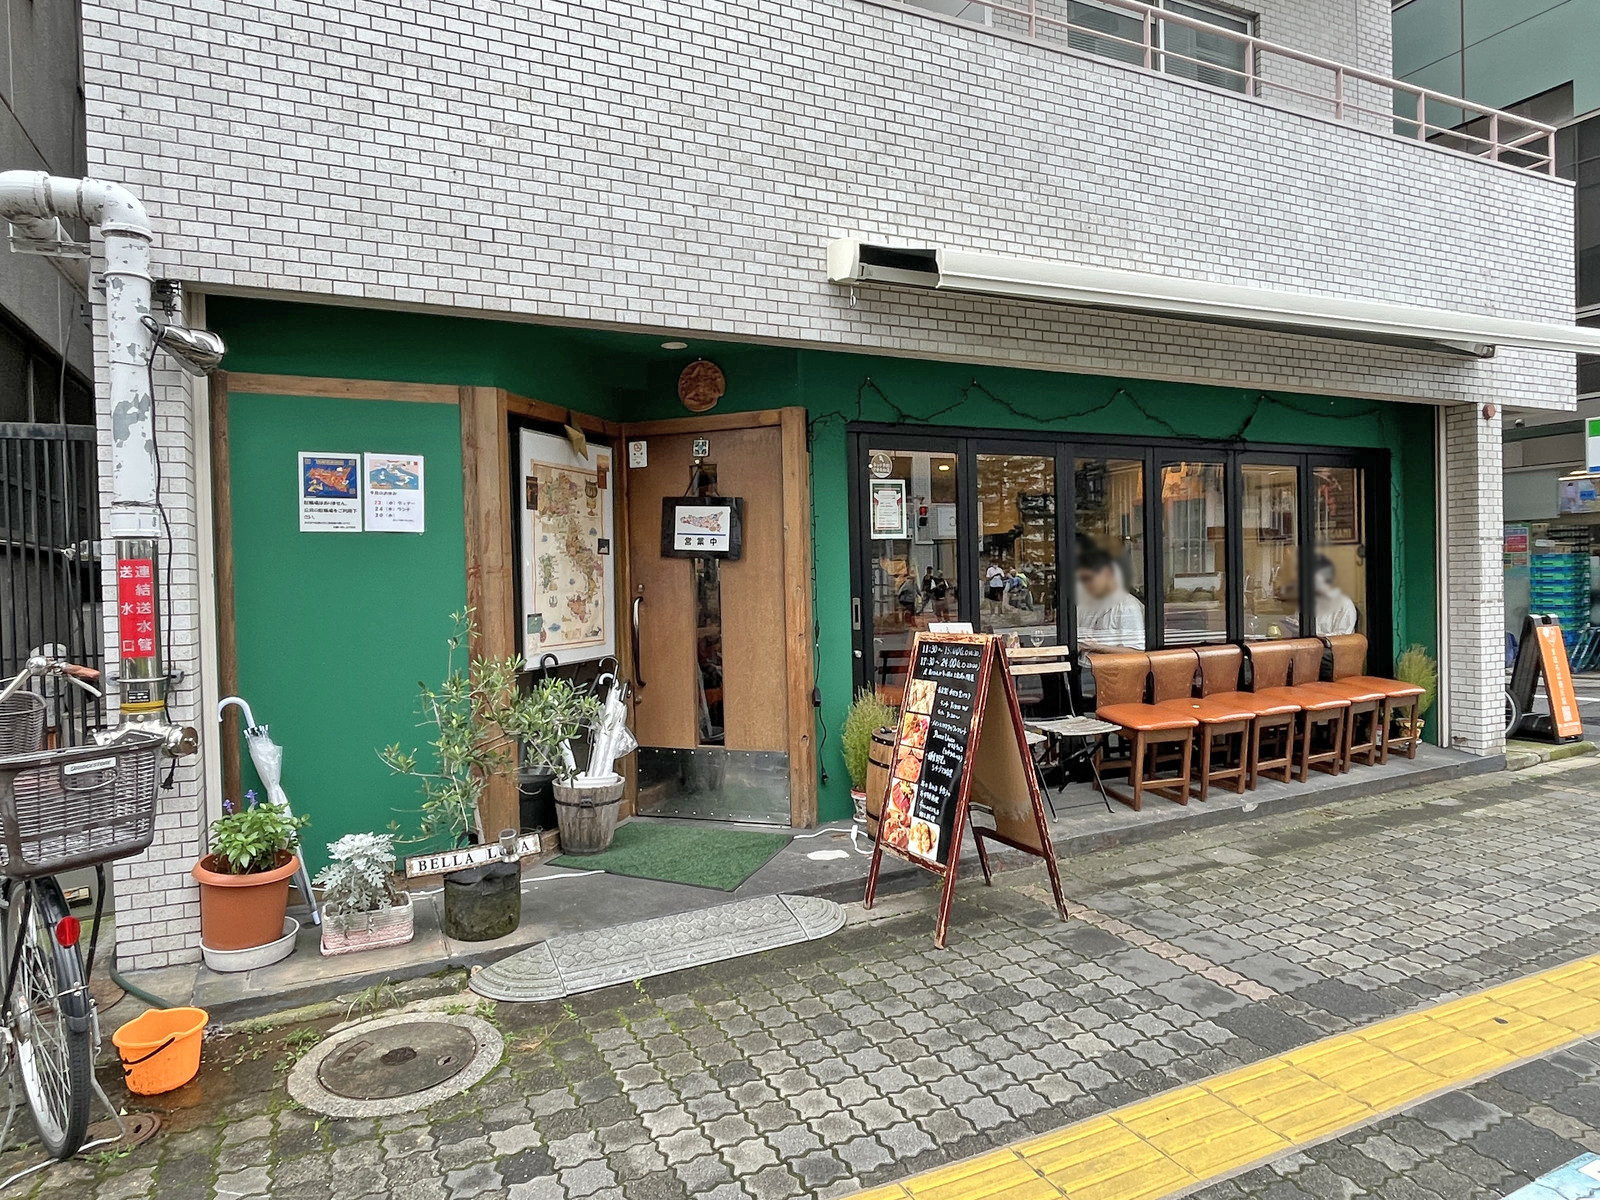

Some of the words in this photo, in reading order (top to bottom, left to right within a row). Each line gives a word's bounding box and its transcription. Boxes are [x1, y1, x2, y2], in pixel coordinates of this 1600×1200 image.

[684, 536, 718, 547] 営業中
[119, 565, 135, 652] 送水口
[134, 565, 153, 652] 連結送水管
[418, 853, 475, 872] BELLA
[487, 841, 530, 860] LA
